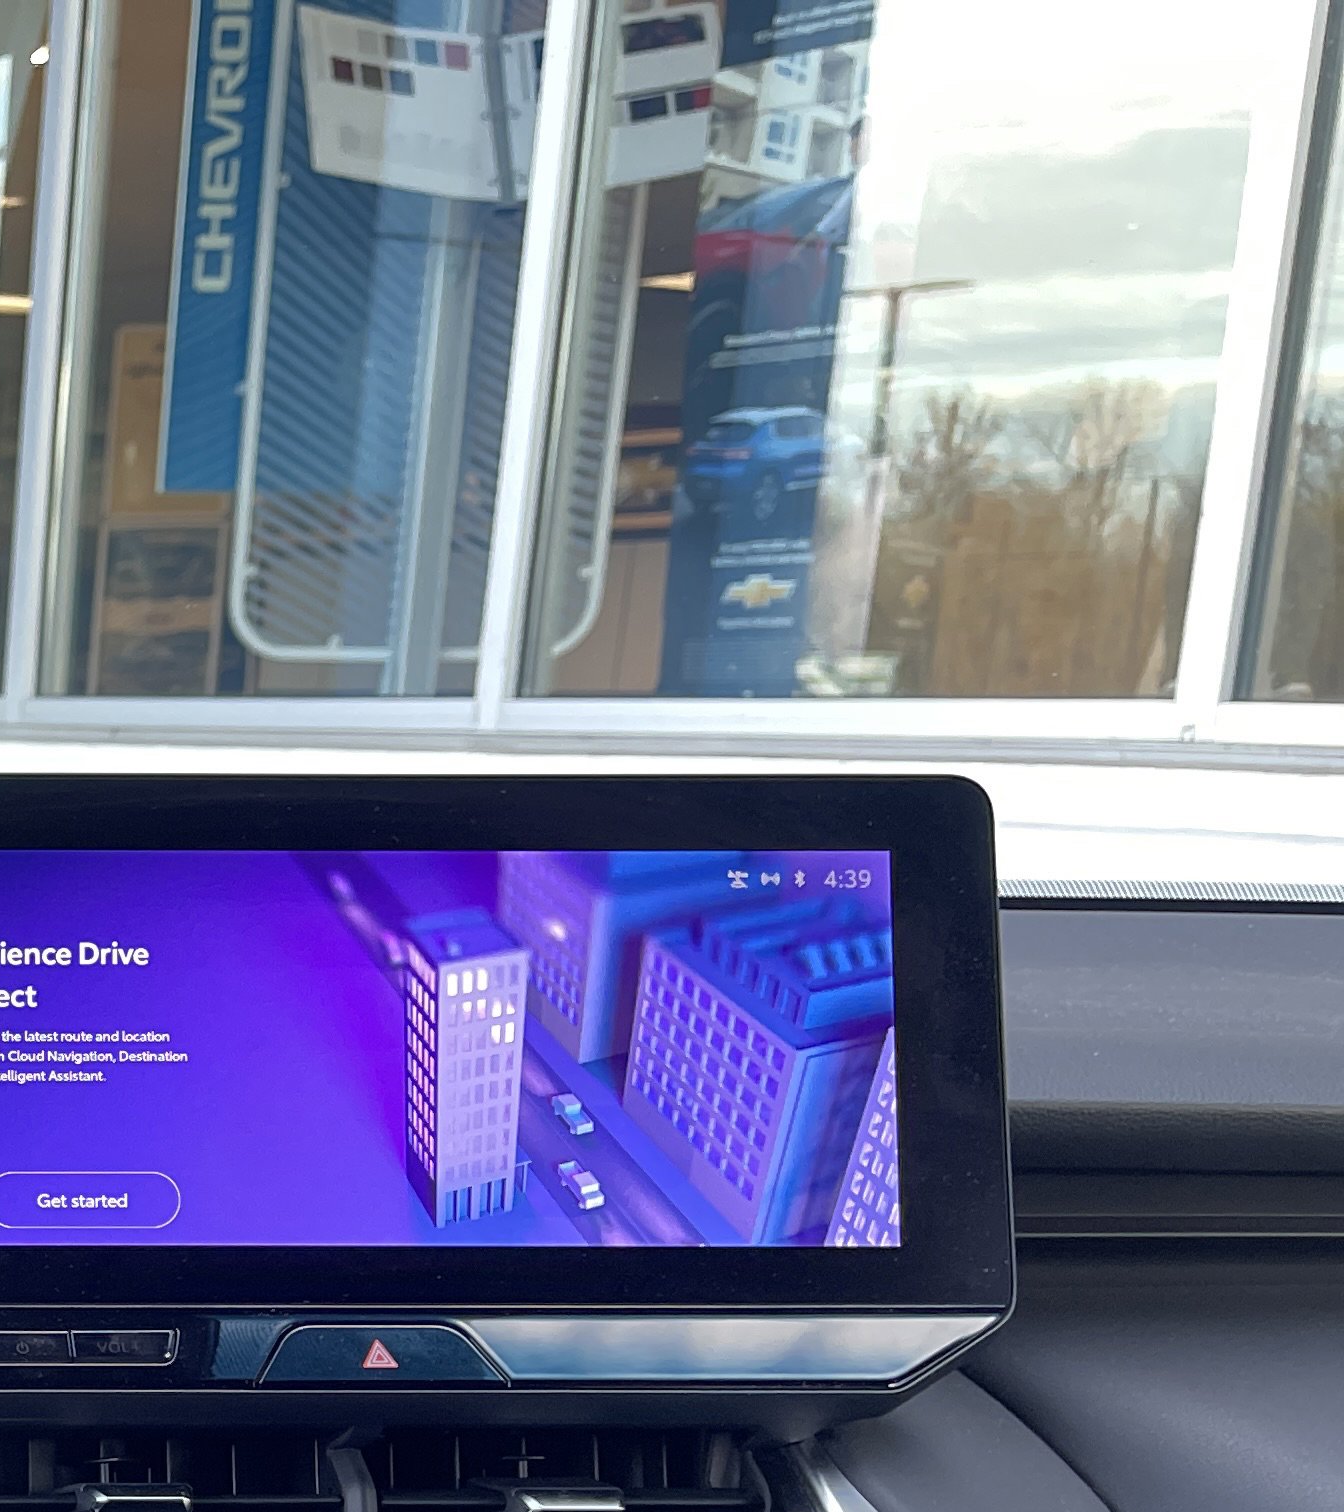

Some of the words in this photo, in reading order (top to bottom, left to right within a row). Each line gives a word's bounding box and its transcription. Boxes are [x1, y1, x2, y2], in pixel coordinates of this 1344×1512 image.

[824, 870, 871, 888] 4:39
[79, 941, 149, 965] Drive
[1, 1031, 21, 1042] the
[25, 1031, 58, 1042] latest
[61, 1032, 93, 1042] route
[95, 1031, 119, 1042] and
[122, 1031, 170, 1042] location
[8, 1050, 44, 1062] Cloud
[48, 1051, 116, 1064] Navigation,
[119, 1051, 188, 1062] Destination
[48, 1071, 106, 1081] Assistant.
[37, 1194, 67, 1208] Get
[71, 1193, 127, 1208] started
